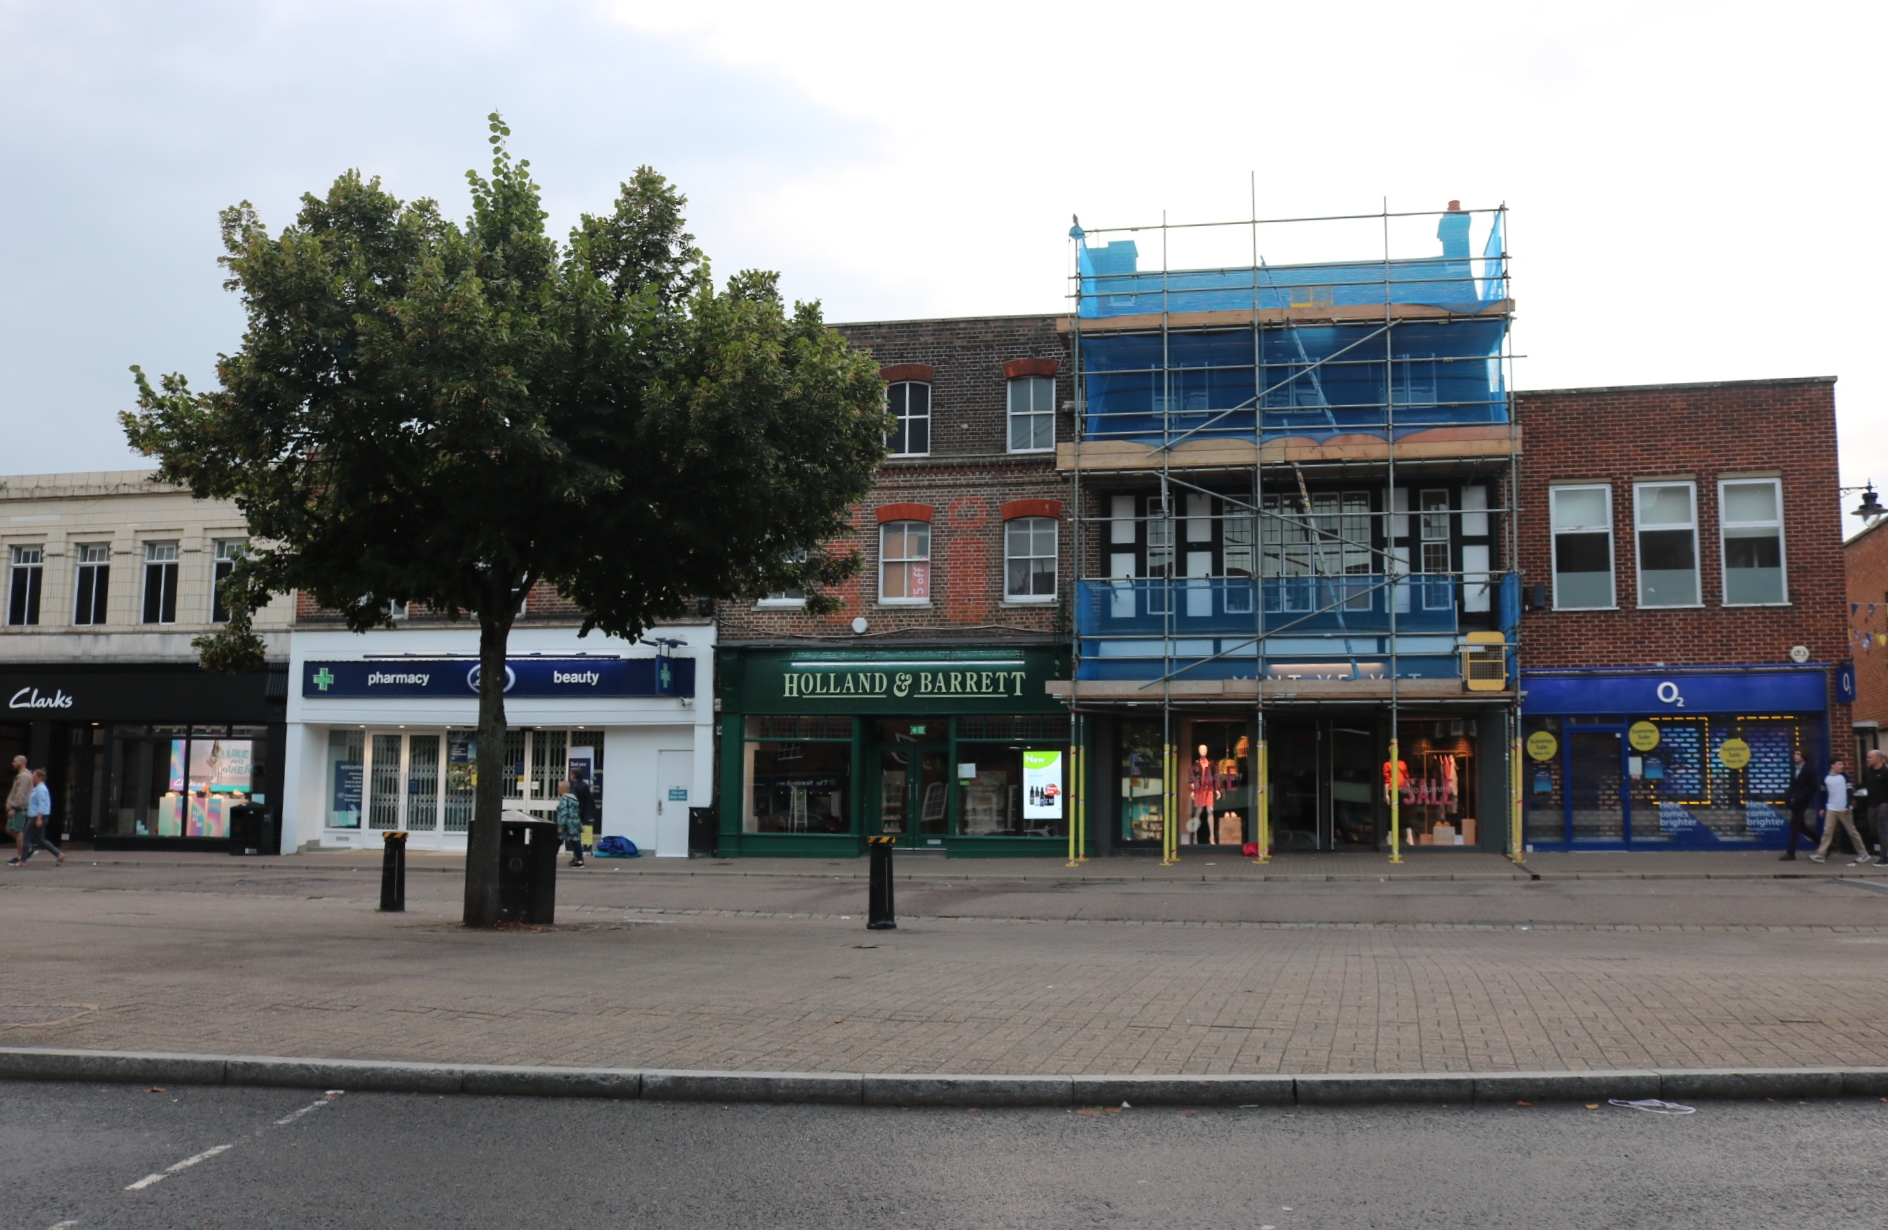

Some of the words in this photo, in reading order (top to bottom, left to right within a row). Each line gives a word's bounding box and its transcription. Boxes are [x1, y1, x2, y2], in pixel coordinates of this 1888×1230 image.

[913, 566, 924, 585] off
[367, 671, 430, 687] pharmacy
[553, 670, 600, 686] beauty
[783, 672, 888, 697] HOLLAND
[893, 673, 913, 698] &
[919, 671, 1027, 696] BARRETT
[9, 686, 73, 708] Clarks
[1656, 681, 1685, 707] O2
[226, 749, 249, 759] LIKE
[1025, 754, 1045, 764] New
[1188, 765, 1238, 791] SALE
[1403, 778, 1454, 805] SALE
[1659, 801, 1681, 809] Here
[1659, 810, 1689, 818] comes
[1659, 818, 1698, 828] brighter
[1746, 817, 1785, 828] brighter
